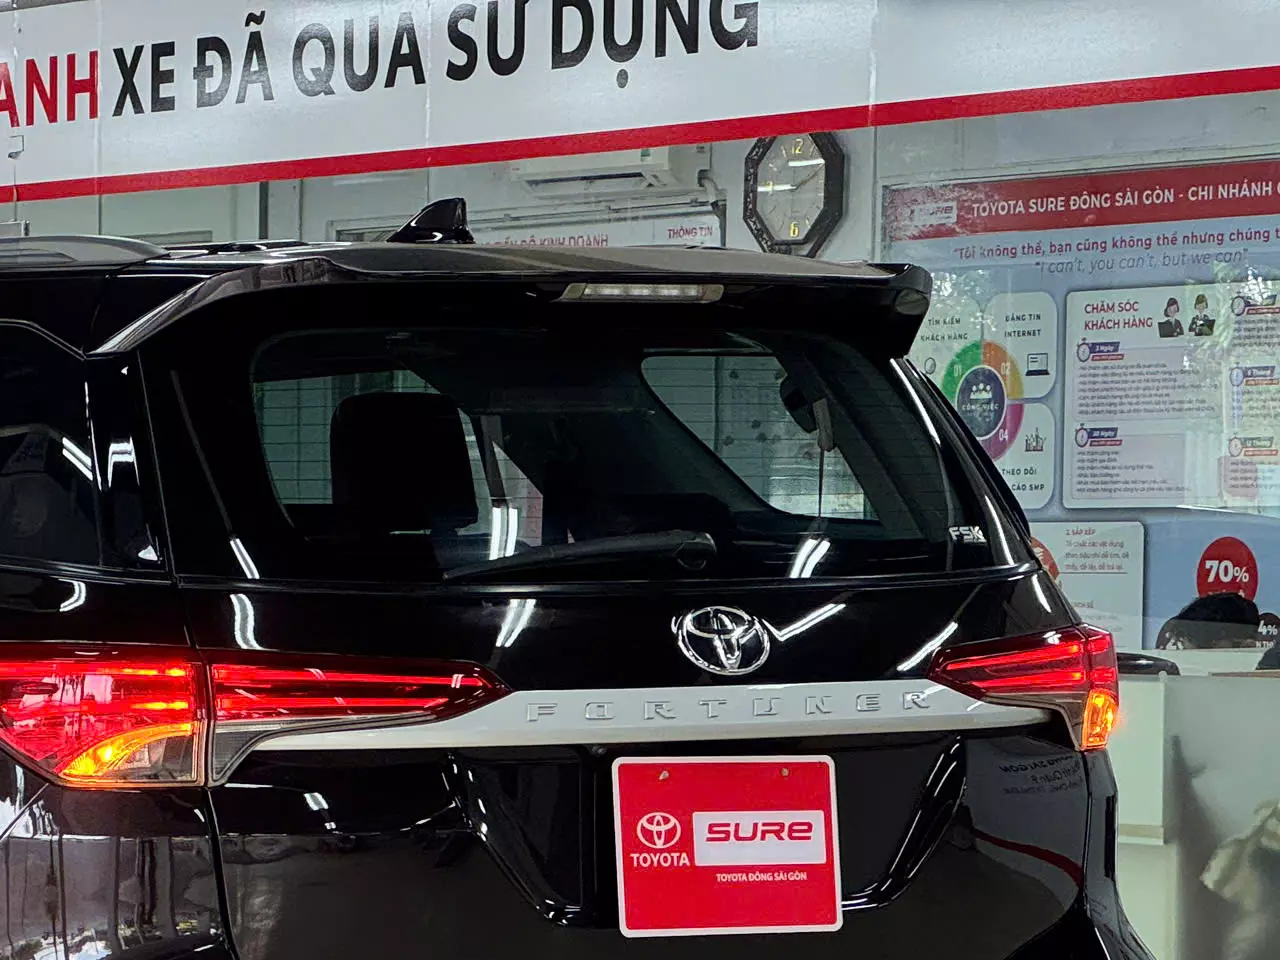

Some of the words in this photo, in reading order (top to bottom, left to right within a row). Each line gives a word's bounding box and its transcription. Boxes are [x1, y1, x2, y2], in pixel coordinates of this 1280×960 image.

[112, 40, 176, 117] XE
[192, 12, 274, 107] ĐÃ
[292, 12, 426, 97] QUA
[551, 0, 759, 89] DỤNG
[972, 199, 1027, 217] TOYOTA
[1028, 196, 1066, 214] SURE
[1070, 190, 1111, 211] ĐÔNG
[1142, 185, 1174, 205] GÒN
[1188, 186, 1213, 202] CHI
[1218, 178, 1272, 199] NHÁNH
[1076, 237, 1107, 253] cũng
[1112, 233, 1152, 250] không
[1182, 231, 1224, 246] nhưng
[1229, 227, 1270, 243] chúng
[1089, 257, 1115, 274] you
[1084, 301, 1115, 314] CHĂM
[1118, 299, 1139, 312] SÓC
[1084, 318, 1120, 331] KHÁCH
[1123, 315, 1153, 328] HÀNG
[1004, 329, 1042, 338] INTERNET
[999, 429, 1008, 441] 04
[1002, 468, 1021, 476] THEO
[1205, 559, 1249, 583] 70%
[526, 690, 931, 723] FORTUNER
[630, 851, 690, 868] TOYOTA
[716, 872, 748, 883] TOYOTA
[749, 871, 773, 882] ĐÔNG
[774, 870, 788, 881] SÀI
[788, 870, 808, 881] GÒN
